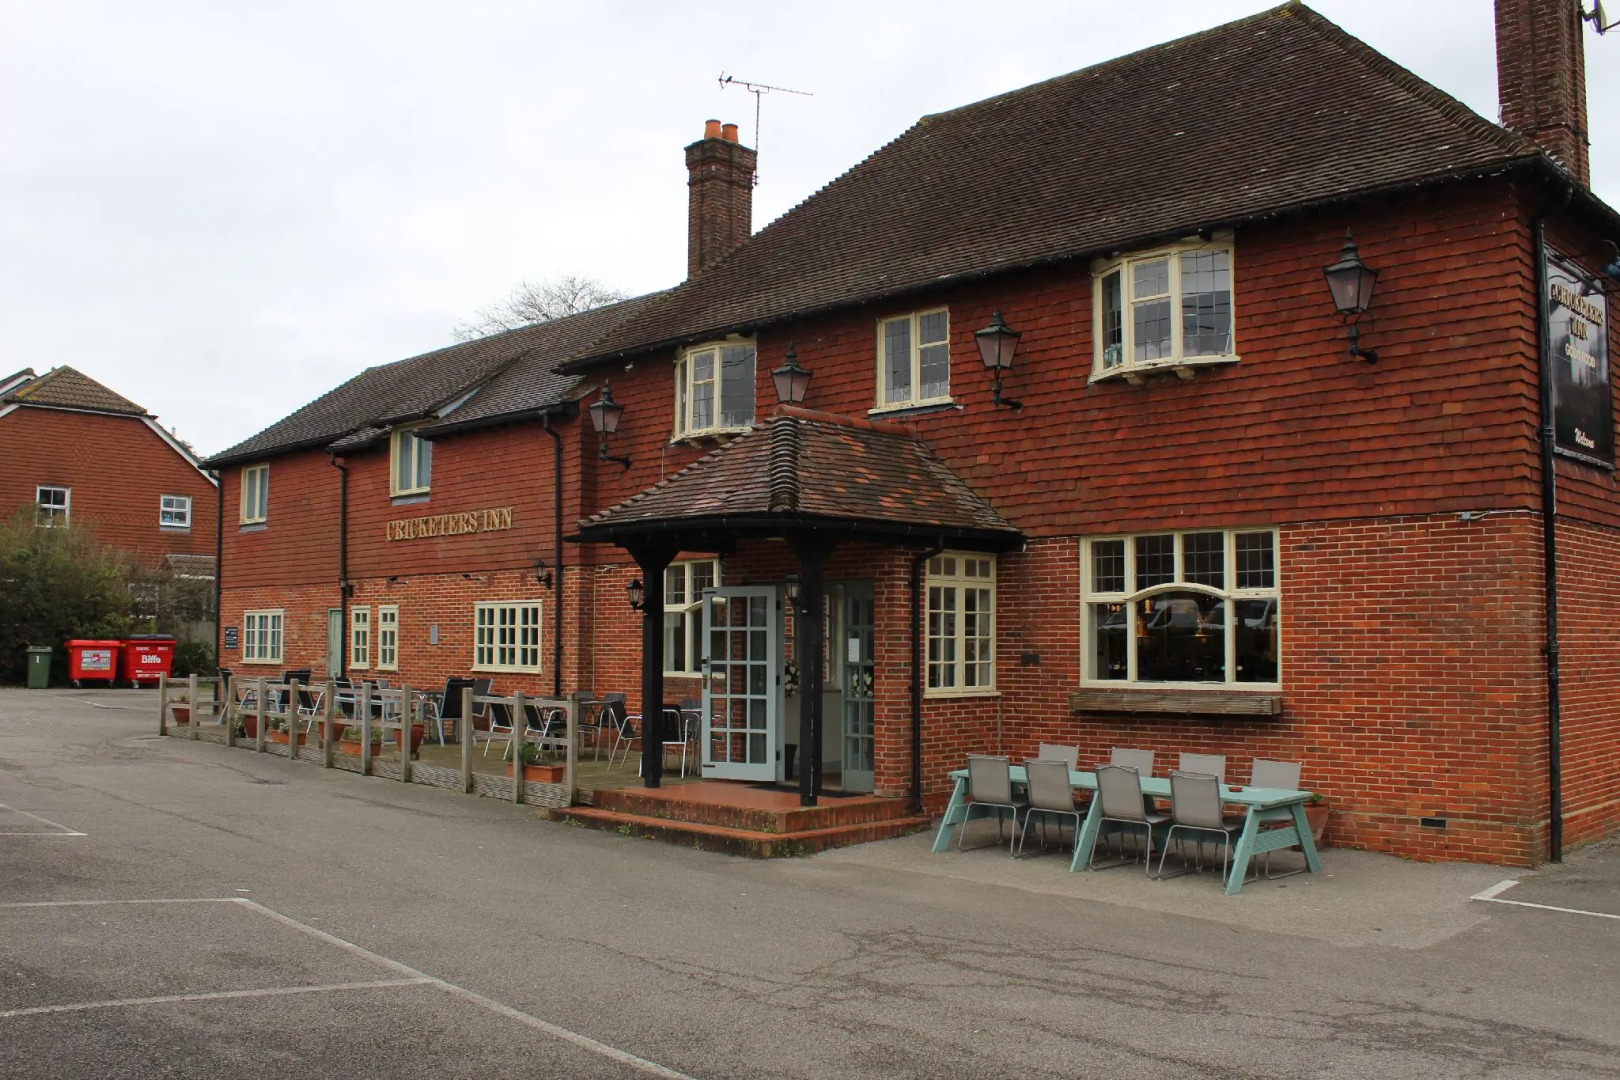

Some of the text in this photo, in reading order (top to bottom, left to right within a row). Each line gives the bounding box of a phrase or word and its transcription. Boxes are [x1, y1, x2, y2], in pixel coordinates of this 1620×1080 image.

[386, 506, 514, 541] CRICKETERS INN
[141, 654, 161, 664] Biffa
